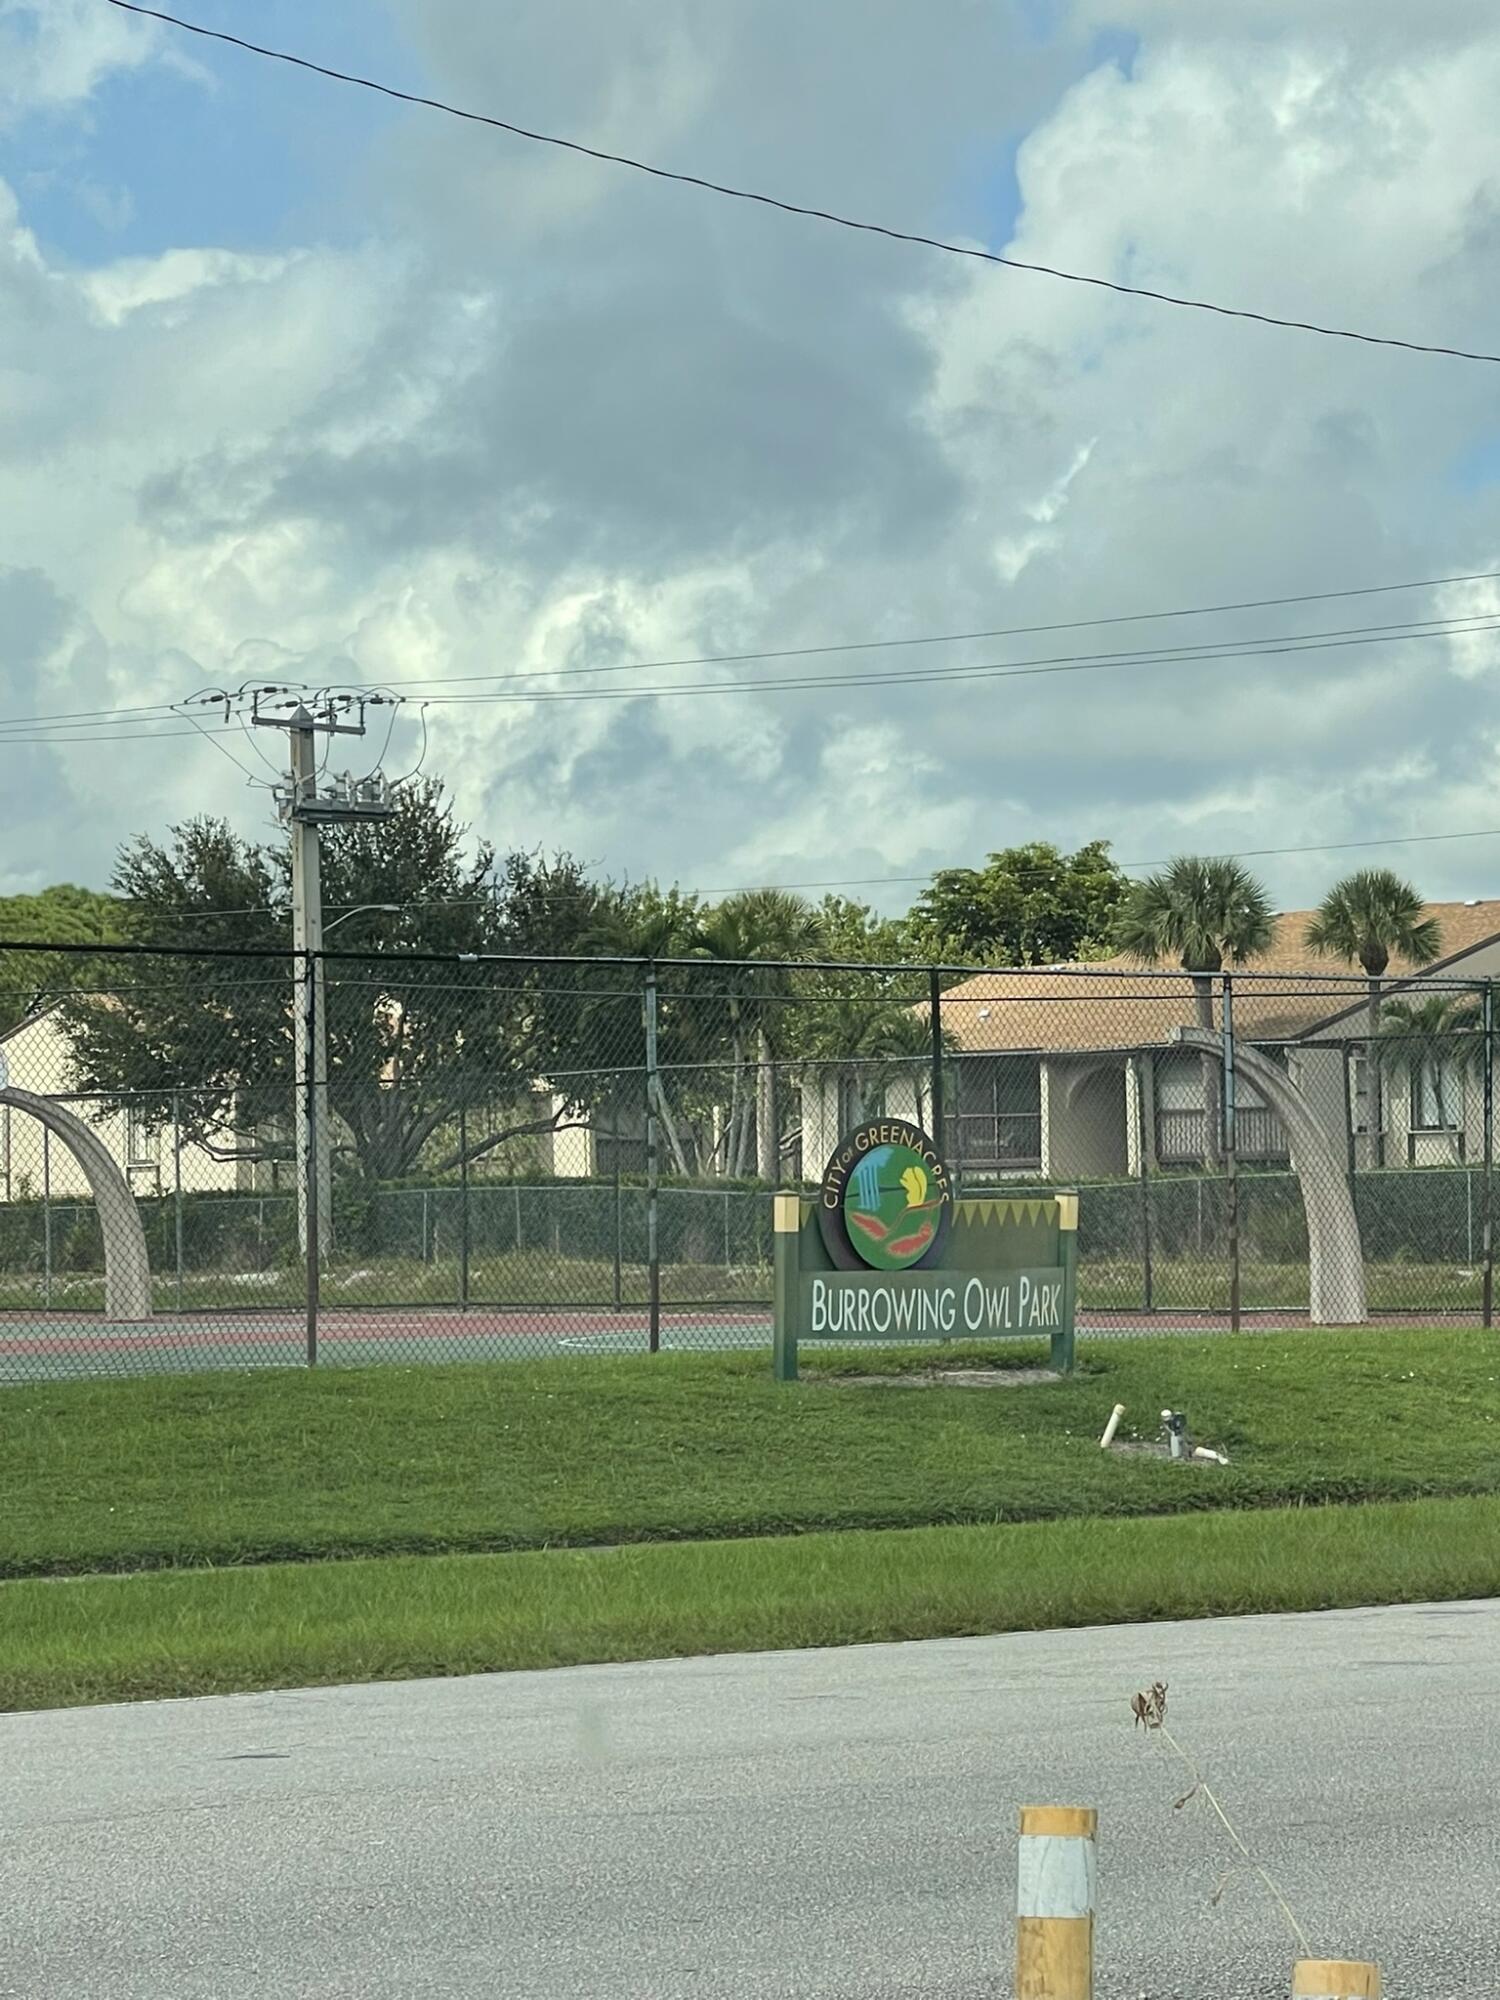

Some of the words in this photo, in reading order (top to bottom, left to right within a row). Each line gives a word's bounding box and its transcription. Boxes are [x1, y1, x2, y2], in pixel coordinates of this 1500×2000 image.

[823, 1158, 847, 1209] CITY
[855, 1125, 950, 1204] GREENACRES
[811, 1279, 956, 1332] BURROWING
[963, 1277, 1012, 1331] OWL
[1018, 1275, 1062, 1327] PARK
